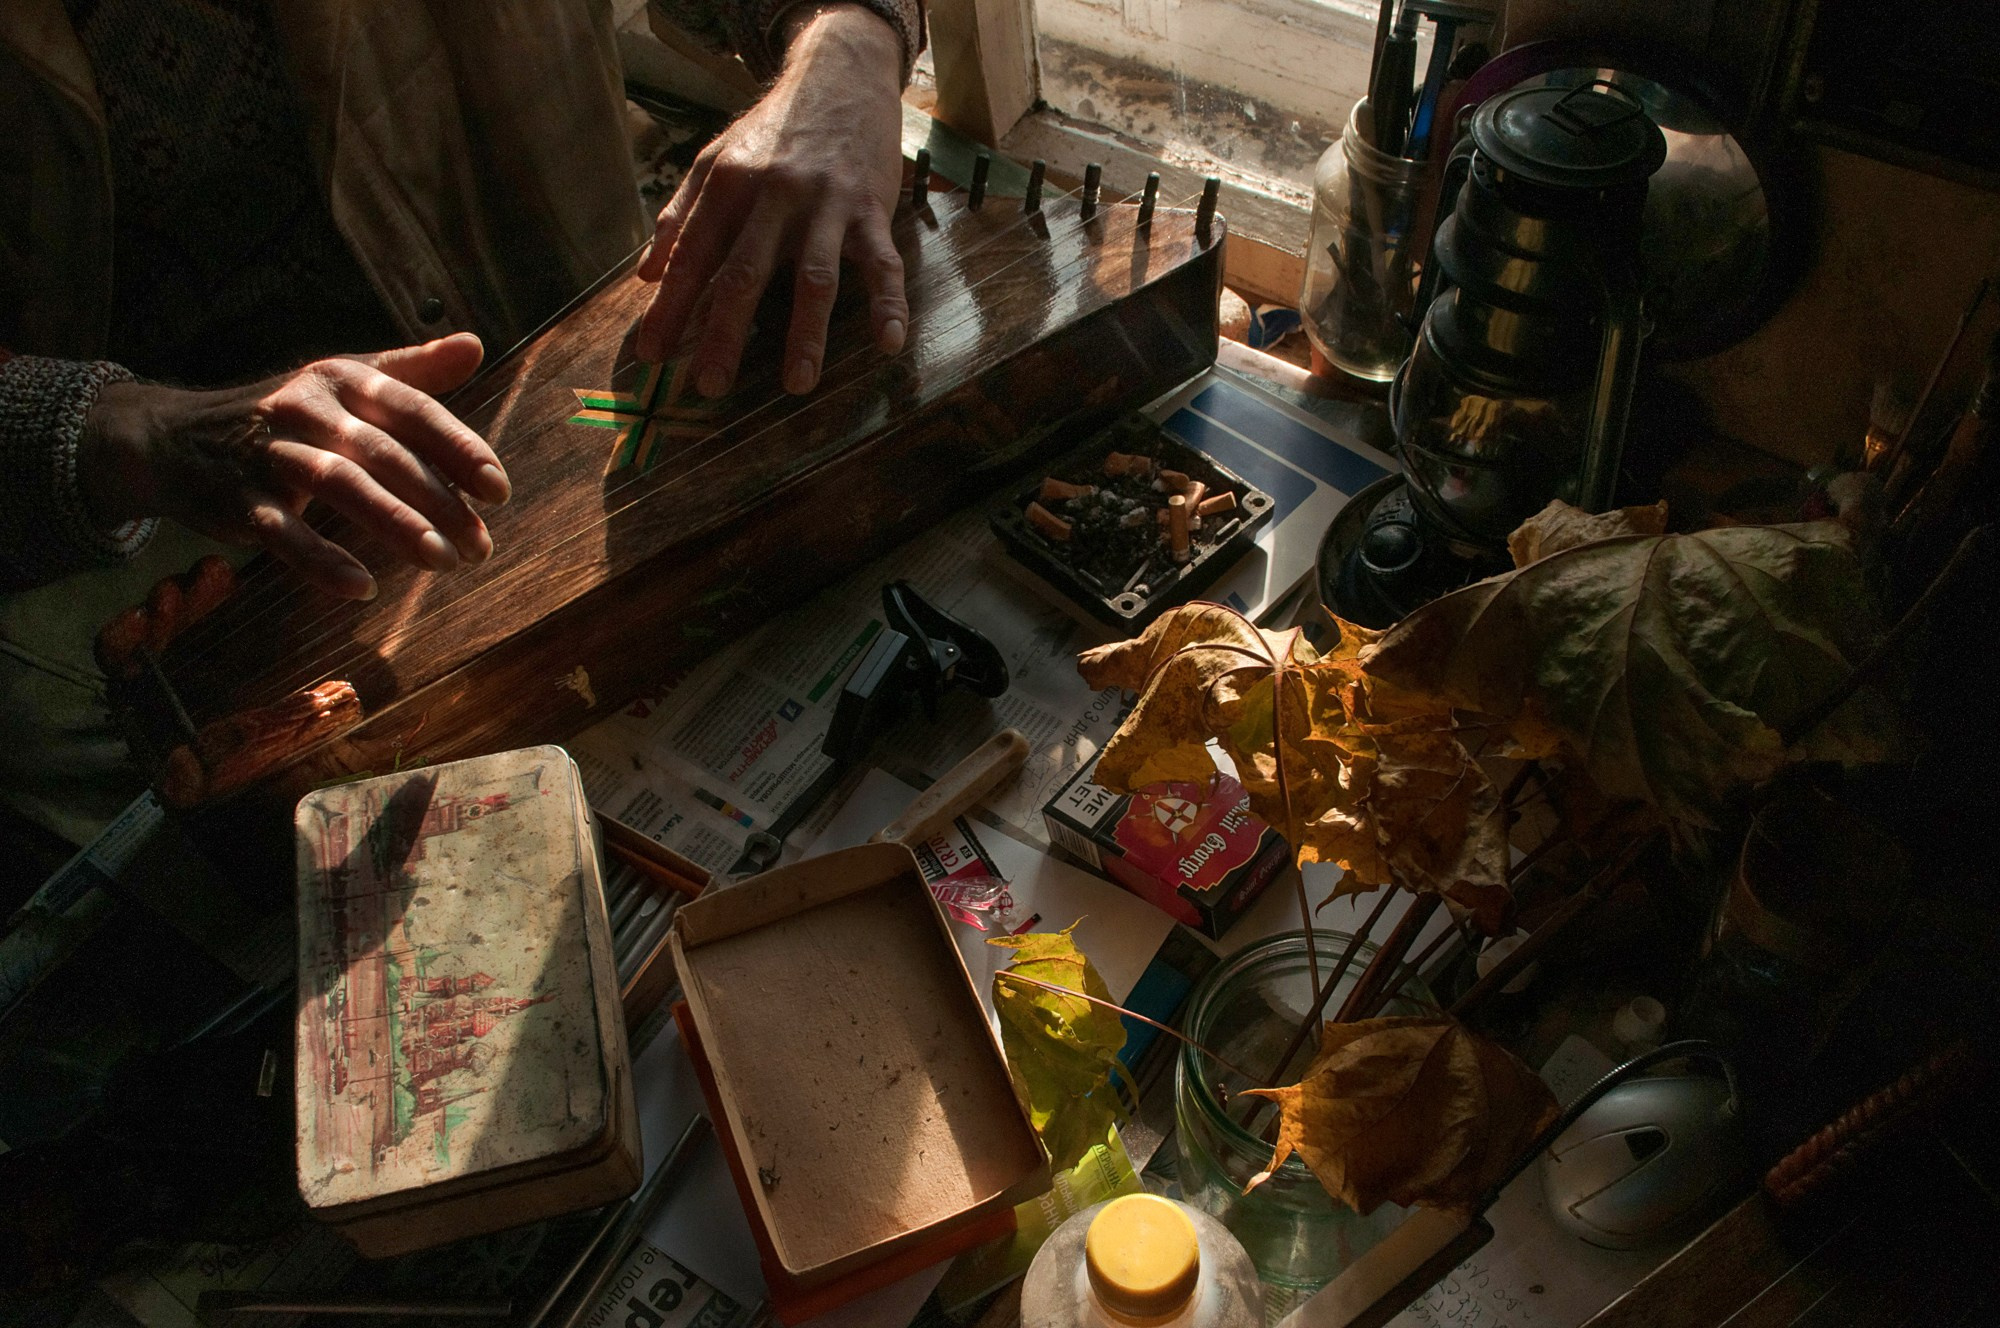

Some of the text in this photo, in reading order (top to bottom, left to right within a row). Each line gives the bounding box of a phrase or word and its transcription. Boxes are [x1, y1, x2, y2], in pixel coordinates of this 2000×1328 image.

[1083, 708, 1099, 726] 3
[1063, 719, 1087, 748] дня
[660, 811, 684, 836] Как
[960, 846, 971, 857] 3V
[1177, 831, 1227, 880] George
